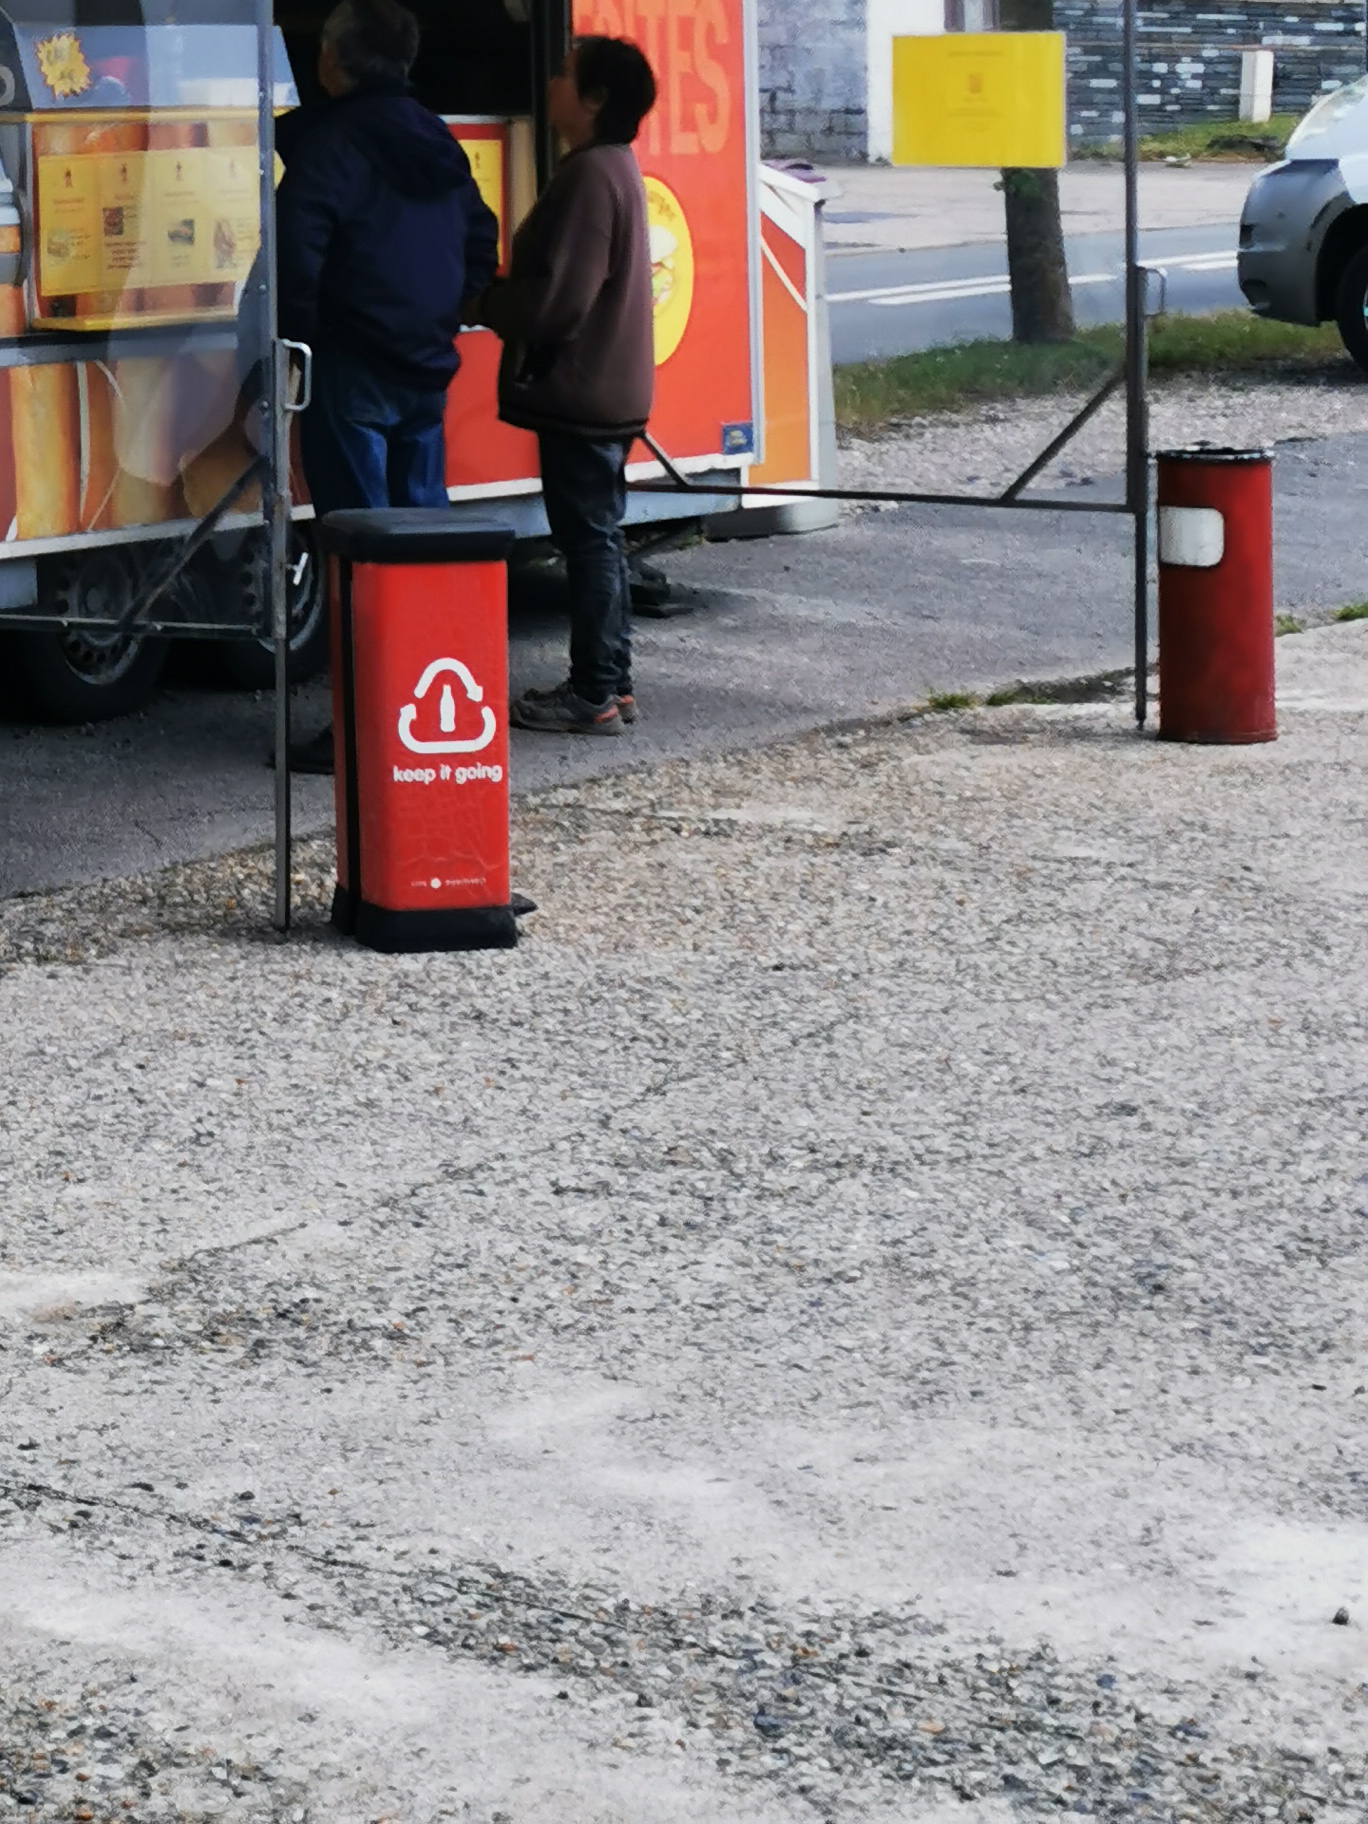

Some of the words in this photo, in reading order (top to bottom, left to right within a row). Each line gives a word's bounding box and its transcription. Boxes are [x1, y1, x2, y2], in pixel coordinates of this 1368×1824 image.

[393, 765, 436, 785] keep
[439, 764, 452, 780] it
[455, 762, 503, 785] going
